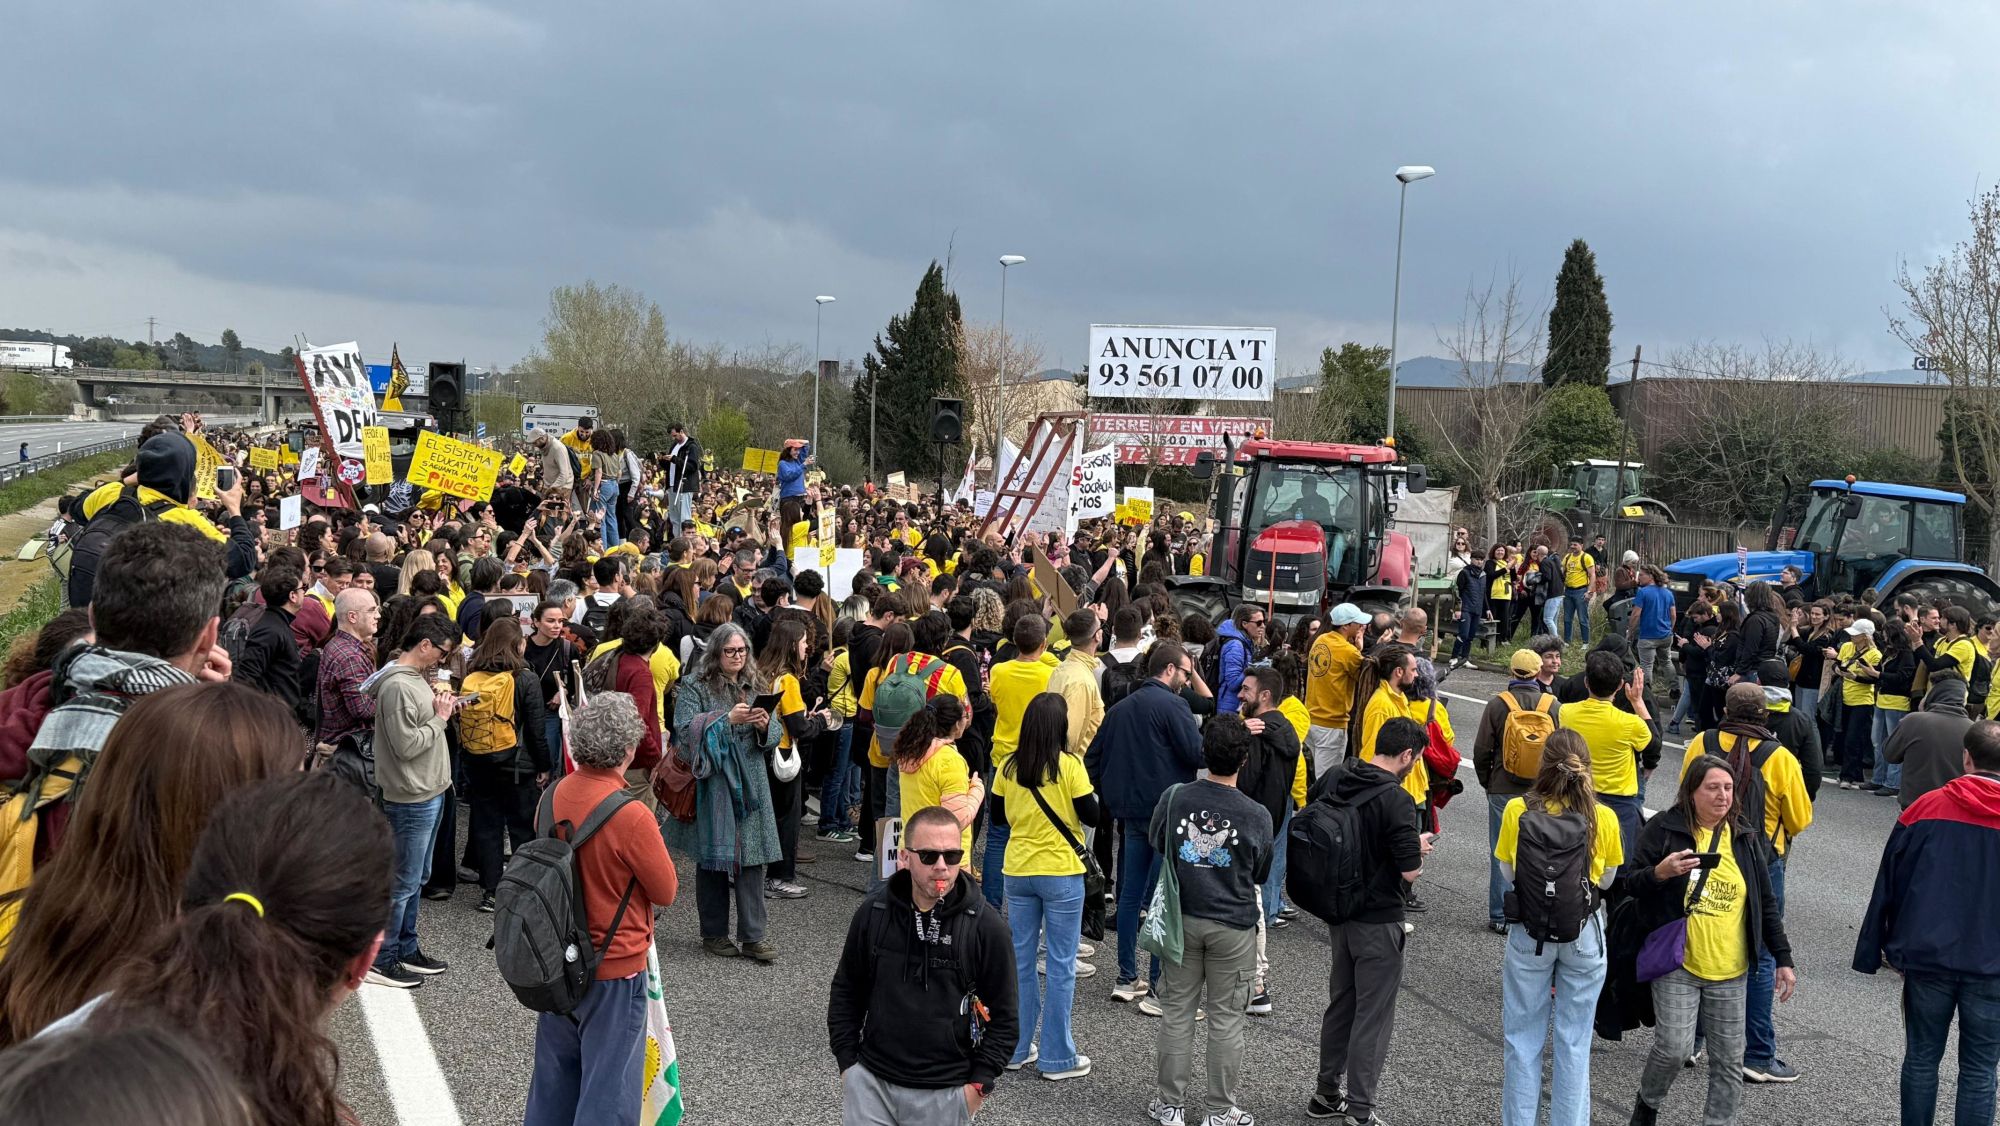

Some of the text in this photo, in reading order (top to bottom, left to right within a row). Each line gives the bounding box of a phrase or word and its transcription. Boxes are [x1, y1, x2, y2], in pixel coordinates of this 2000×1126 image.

[1101, 337, 1266, 361] ANUNCIA'T
[1099, 363, 1263, 390] 93 561 07 00
[1180, 420, 1204, 434] EN
[426, 438, 438, 450] EL
[463, 473, 478, 482] AMB
